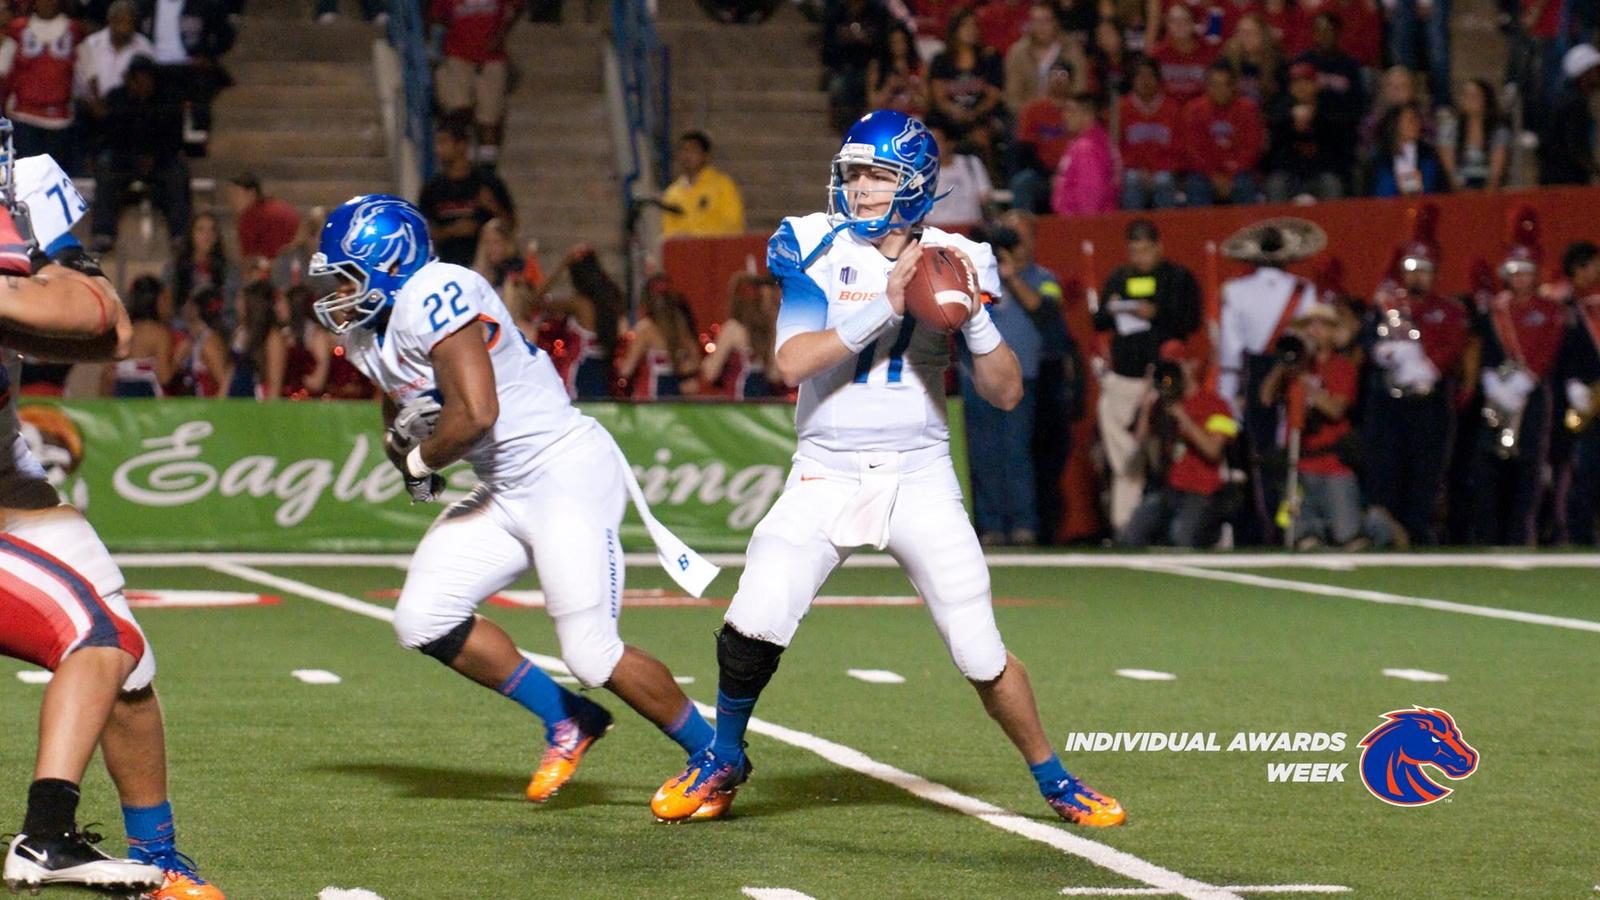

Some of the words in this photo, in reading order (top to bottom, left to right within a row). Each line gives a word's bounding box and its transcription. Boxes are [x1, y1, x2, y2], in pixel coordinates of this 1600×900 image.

[423, 280, 469, 332] 22
[838, 290, 880, 302] BOIS
[114, 420, 405, 527] Eagle
[606, 528, 618, 618] BRONCOS
